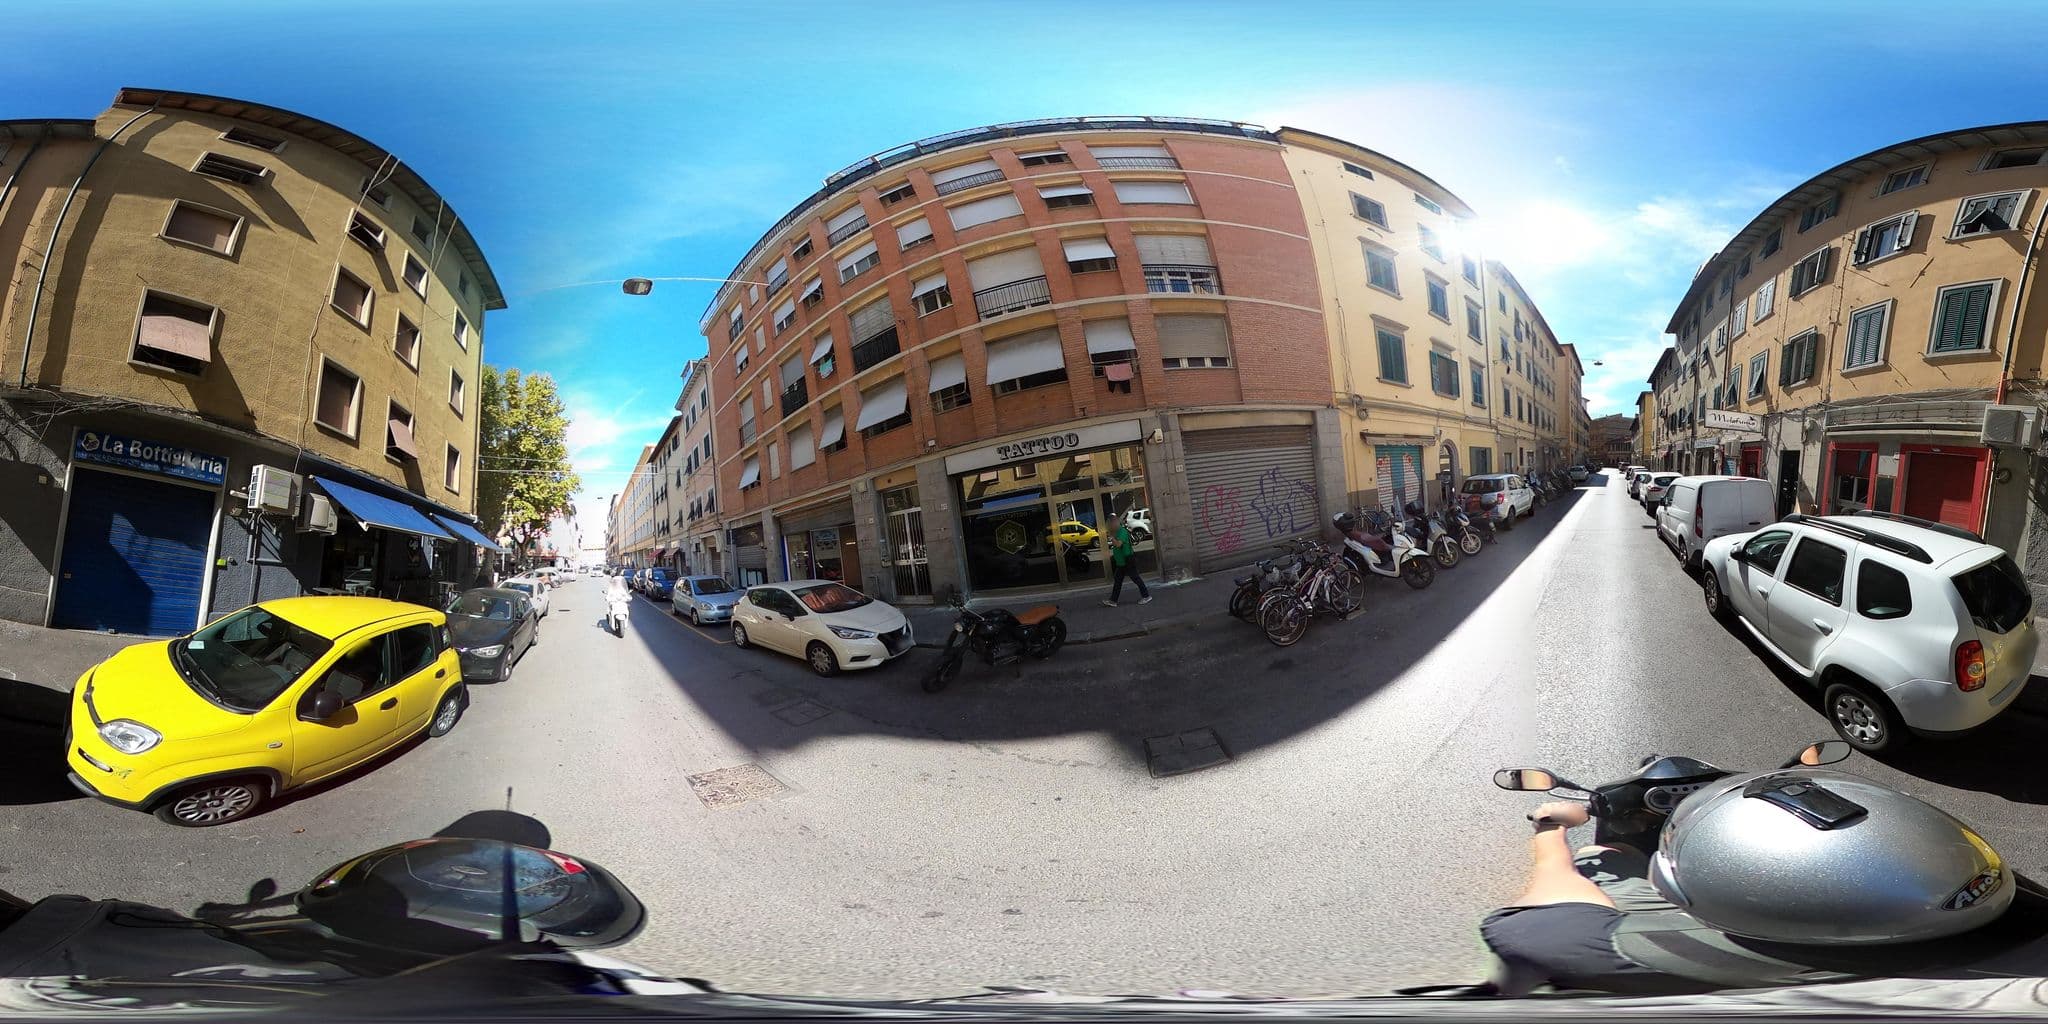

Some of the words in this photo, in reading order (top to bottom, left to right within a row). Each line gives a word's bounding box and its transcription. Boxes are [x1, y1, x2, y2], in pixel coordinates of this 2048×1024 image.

[102, 433, 124, 455] La
[130, 440, 223, 476] Bottiglieria
[997, 432, 1080, 461] TATTOO
